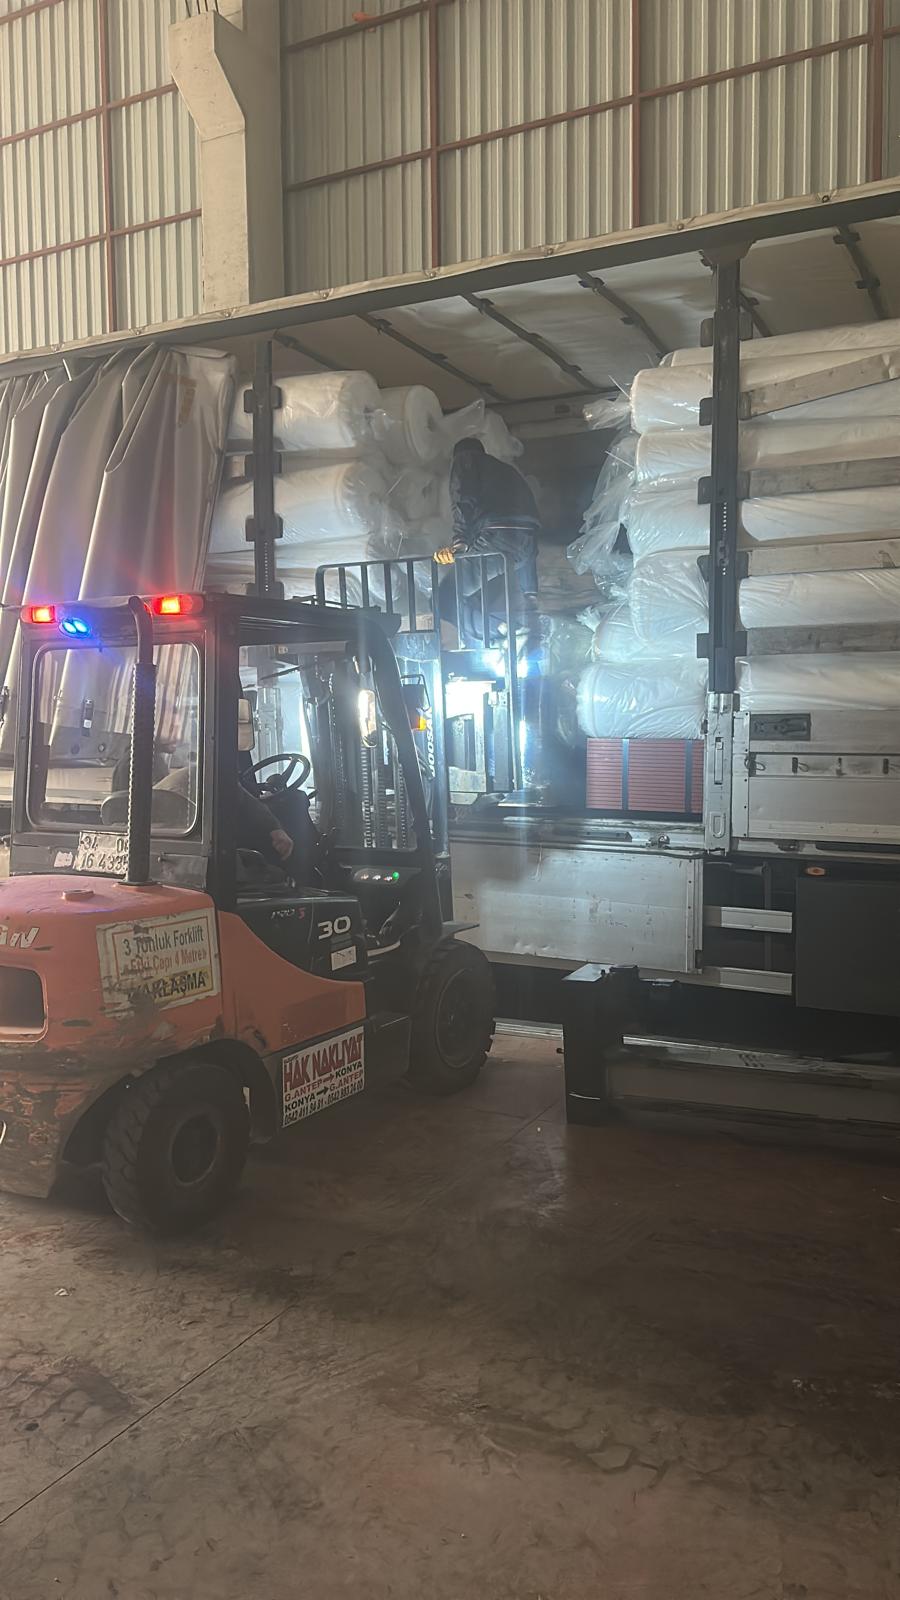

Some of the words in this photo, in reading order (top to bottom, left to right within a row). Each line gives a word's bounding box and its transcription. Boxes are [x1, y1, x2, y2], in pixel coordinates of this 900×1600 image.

[84, 836, 98, 851] 34
[80, 853, 94, 868] 16
[123, 939, 131, 956] 3
[134, 931, 171, 954] Tonluk
[174, 925, 204, 946] Forklift
[318, 916, 351, 940] 30
[175, 949, 180, 966] 4
[284, 1055, 311, 1093] HAK
[285, 1080, 323, 1102] G.ANTEP
[335, 1061, 363, 1079] KONYA
[285, 1093, 315, 1113] KONYA
[329, 1069, 364, 1091] G.ANTEP
